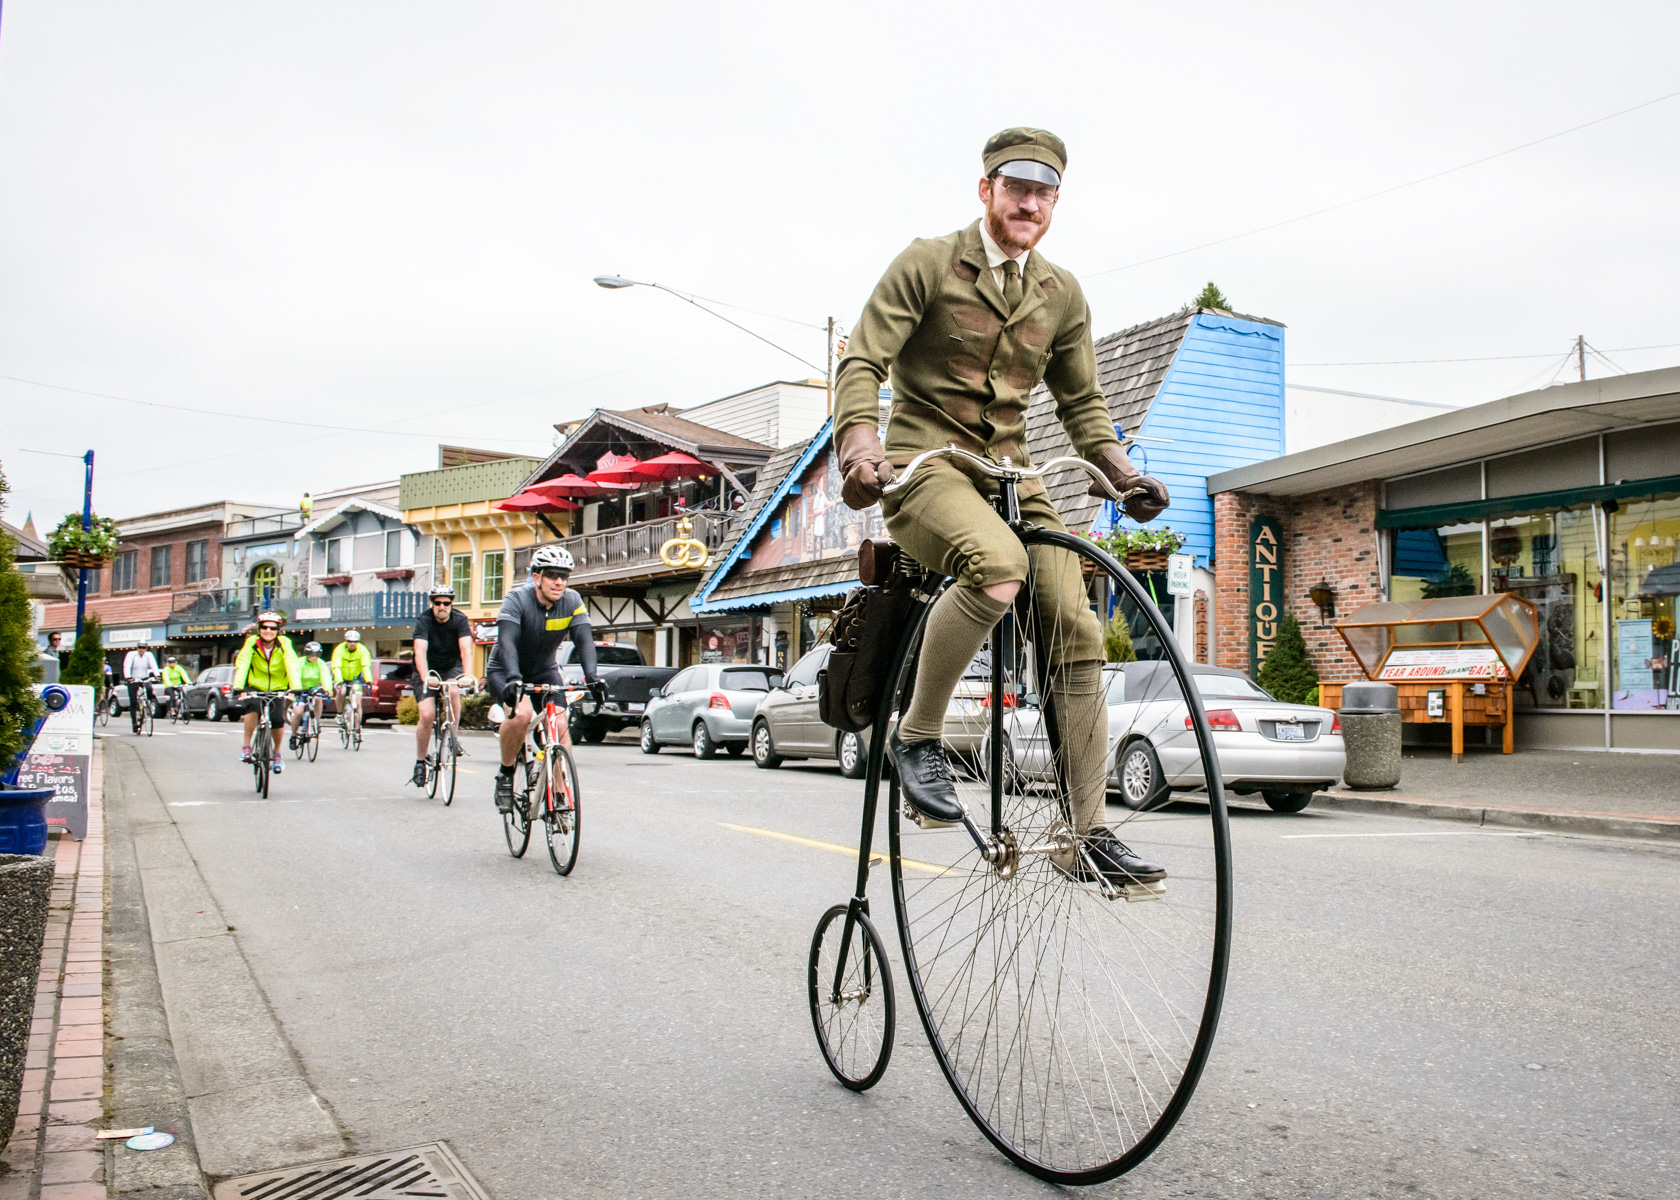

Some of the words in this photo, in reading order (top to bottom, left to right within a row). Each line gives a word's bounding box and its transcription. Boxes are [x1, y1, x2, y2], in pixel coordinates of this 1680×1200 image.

[1178, 561, 1183, 569] 2
[1173, 571, 1187, 579] HOUR
[1170, 581, 1189, 590] PARKING
[1383, 668, 1406, 677] YEAR
[1407, 666, 1446, 677] AROUND
[36, 772, 75, 784] Flavors
